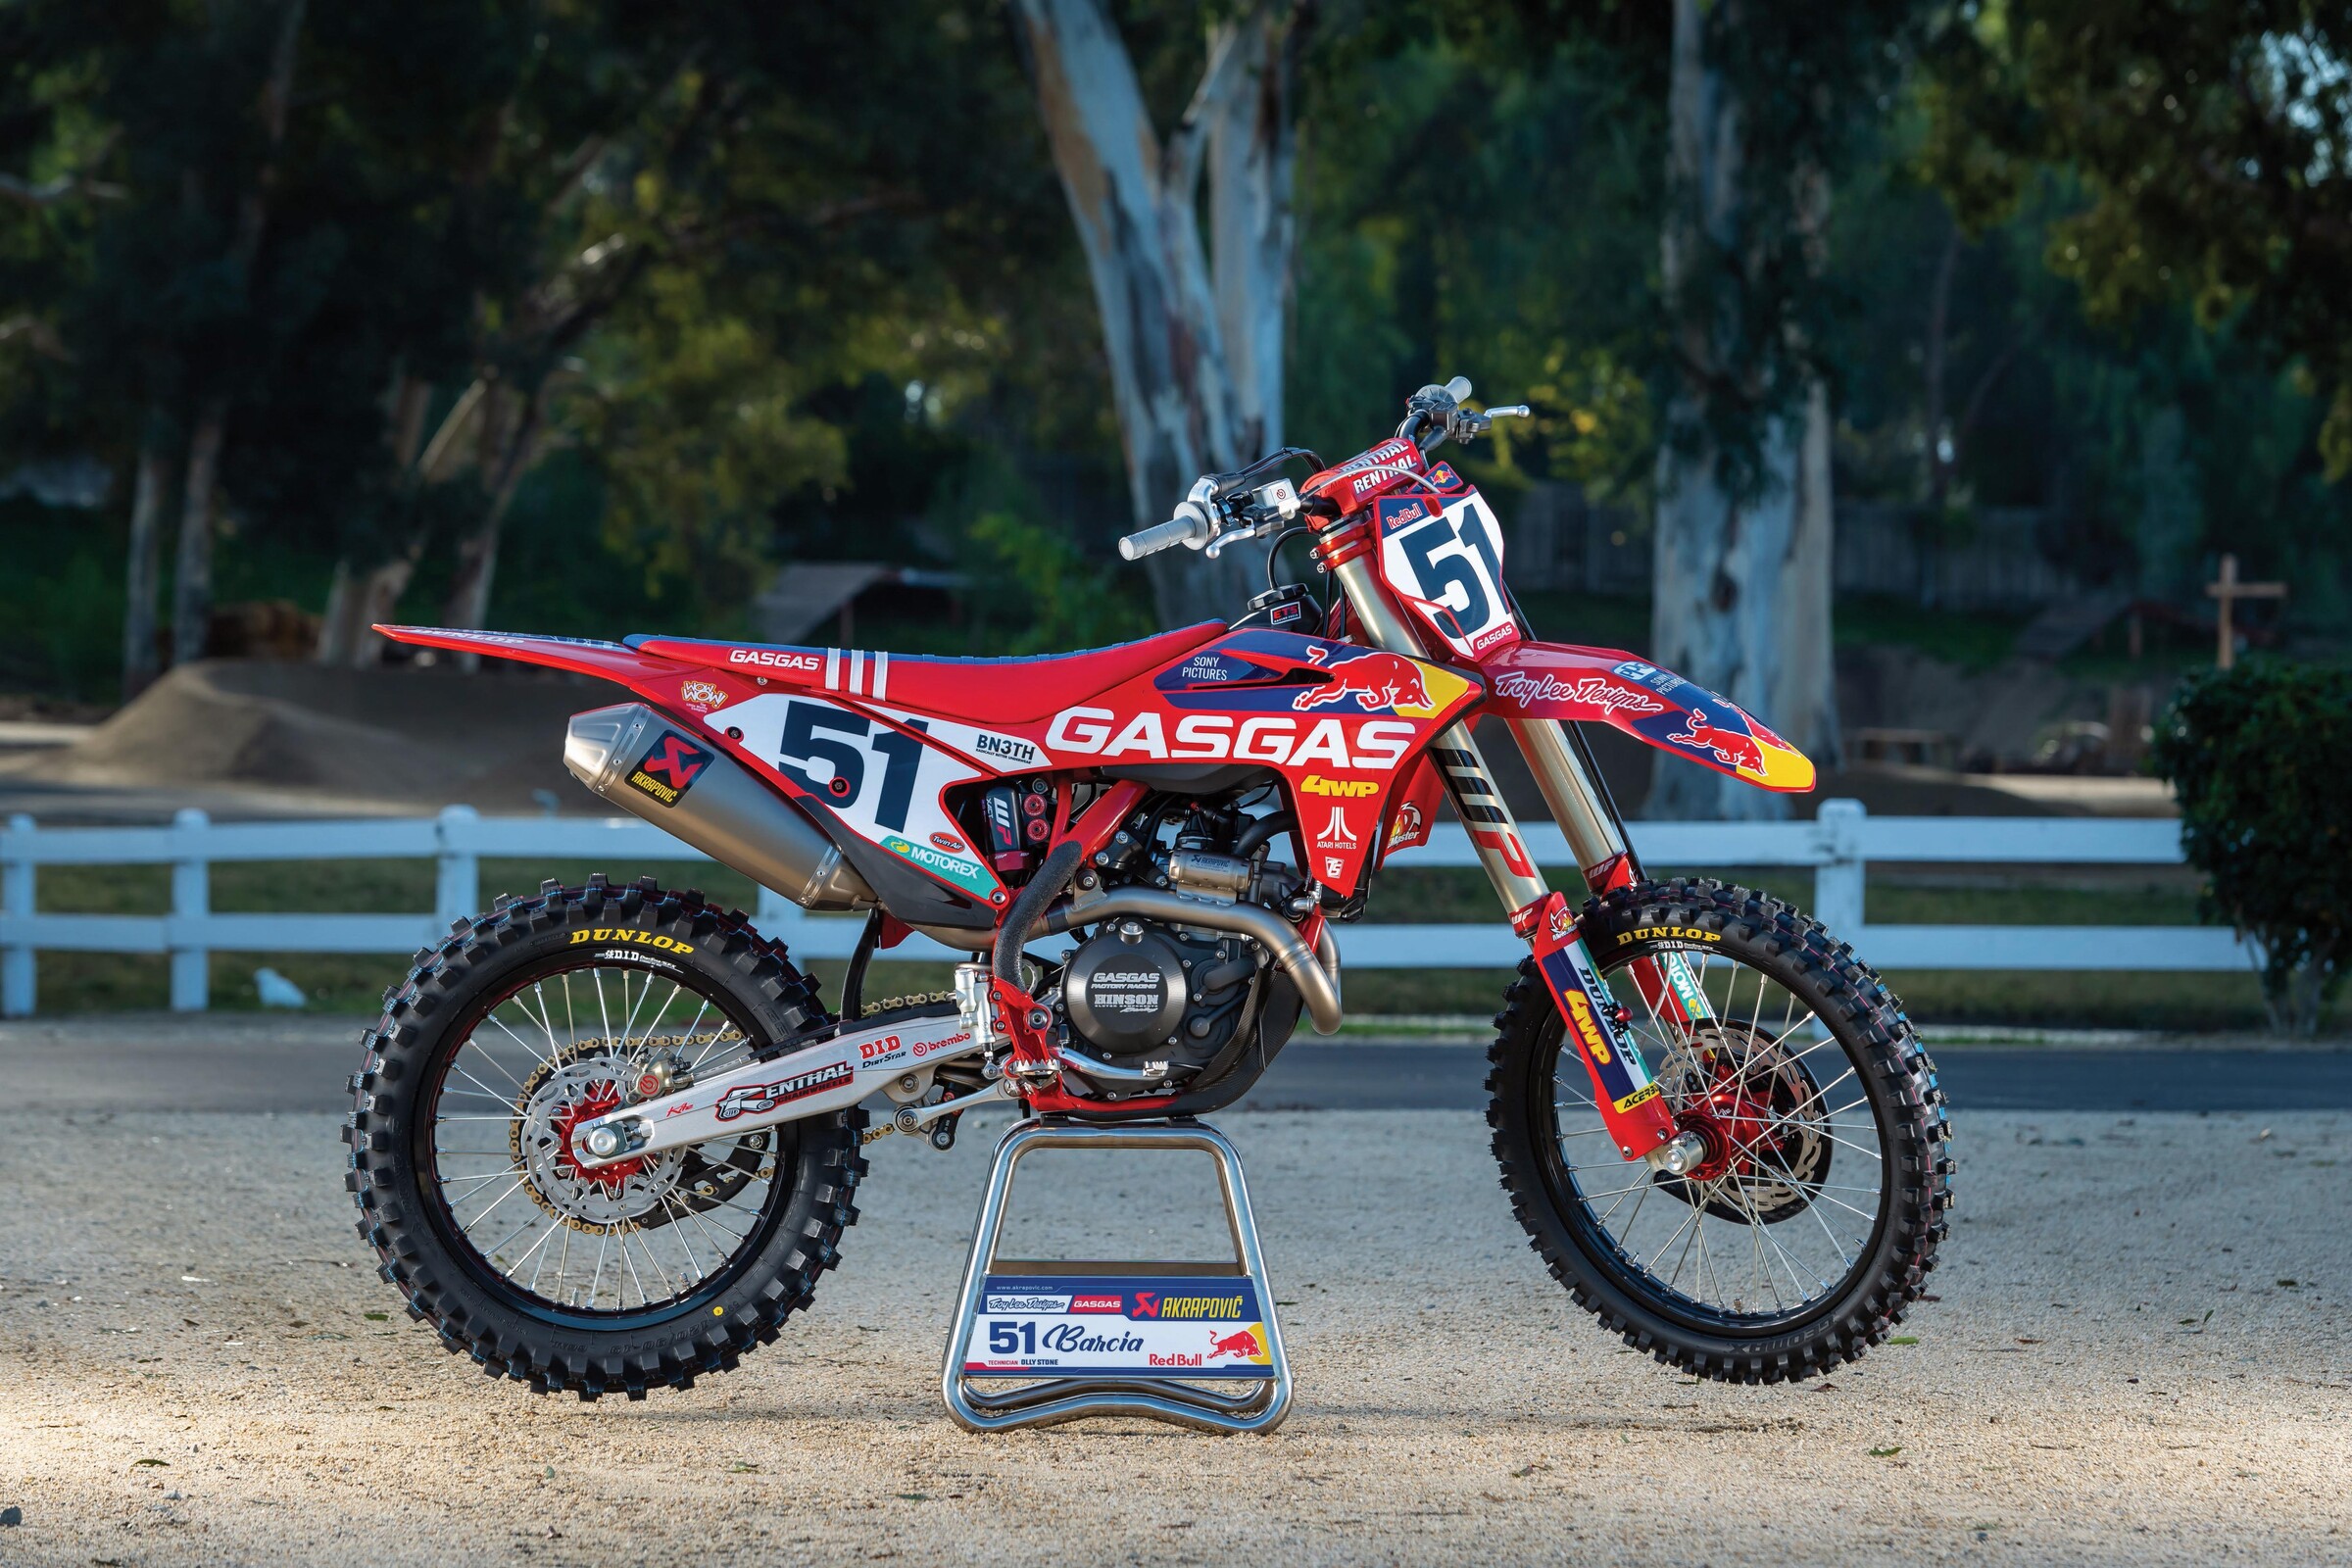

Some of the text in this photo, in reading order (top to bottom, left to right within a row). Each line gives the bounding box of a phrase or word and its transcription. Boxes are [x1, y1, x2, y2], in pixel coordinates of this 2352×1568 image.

[1352, 454, 1418, 495] RENTHAL
[1386, 503, 1423, 530] Red Bull
[1398, 503, 1511, 640] 51
[1476, 624, 1512, 650] GASGAS
[729, 649, 820, 671] GASGAS
[1193, 656, 1220, 668] SONY
[684, 681, 716, 693] WOW
[1182, 666, 1228, 682] PICTURES
[1495, 671, 1664, 715] Troy Lee Designs
[976, 734, 1036, 760] BN3TH
[1045, 706, 1415, 769] GASGAS
[778, 700, 929, 834] 51
[993, 797, 1012, 846] WP
[933, 836, 963, 850] Twin Air
[911, 846, 980, 879] MOTOREX
[569, 928, 694, 955] DUNLOP
[1616, 926, 1722, 946] DUNLOP
[1093, 972, 1160, 983] GASGAS
[1094, 994, 1159, 1005] HINSON
[859, 1035, 902, 1060] D.I.D
[928, 1032, 971, 1052] brembo
[776, 1076, 853, 1104] CHAINWHEELS
[989, 1298, 1065, 1311] Troy Lee Designs
[989, 1321, 1144, 1354] 51 Barcia
[1149, 1353, 1202, 1366] Red Bull
